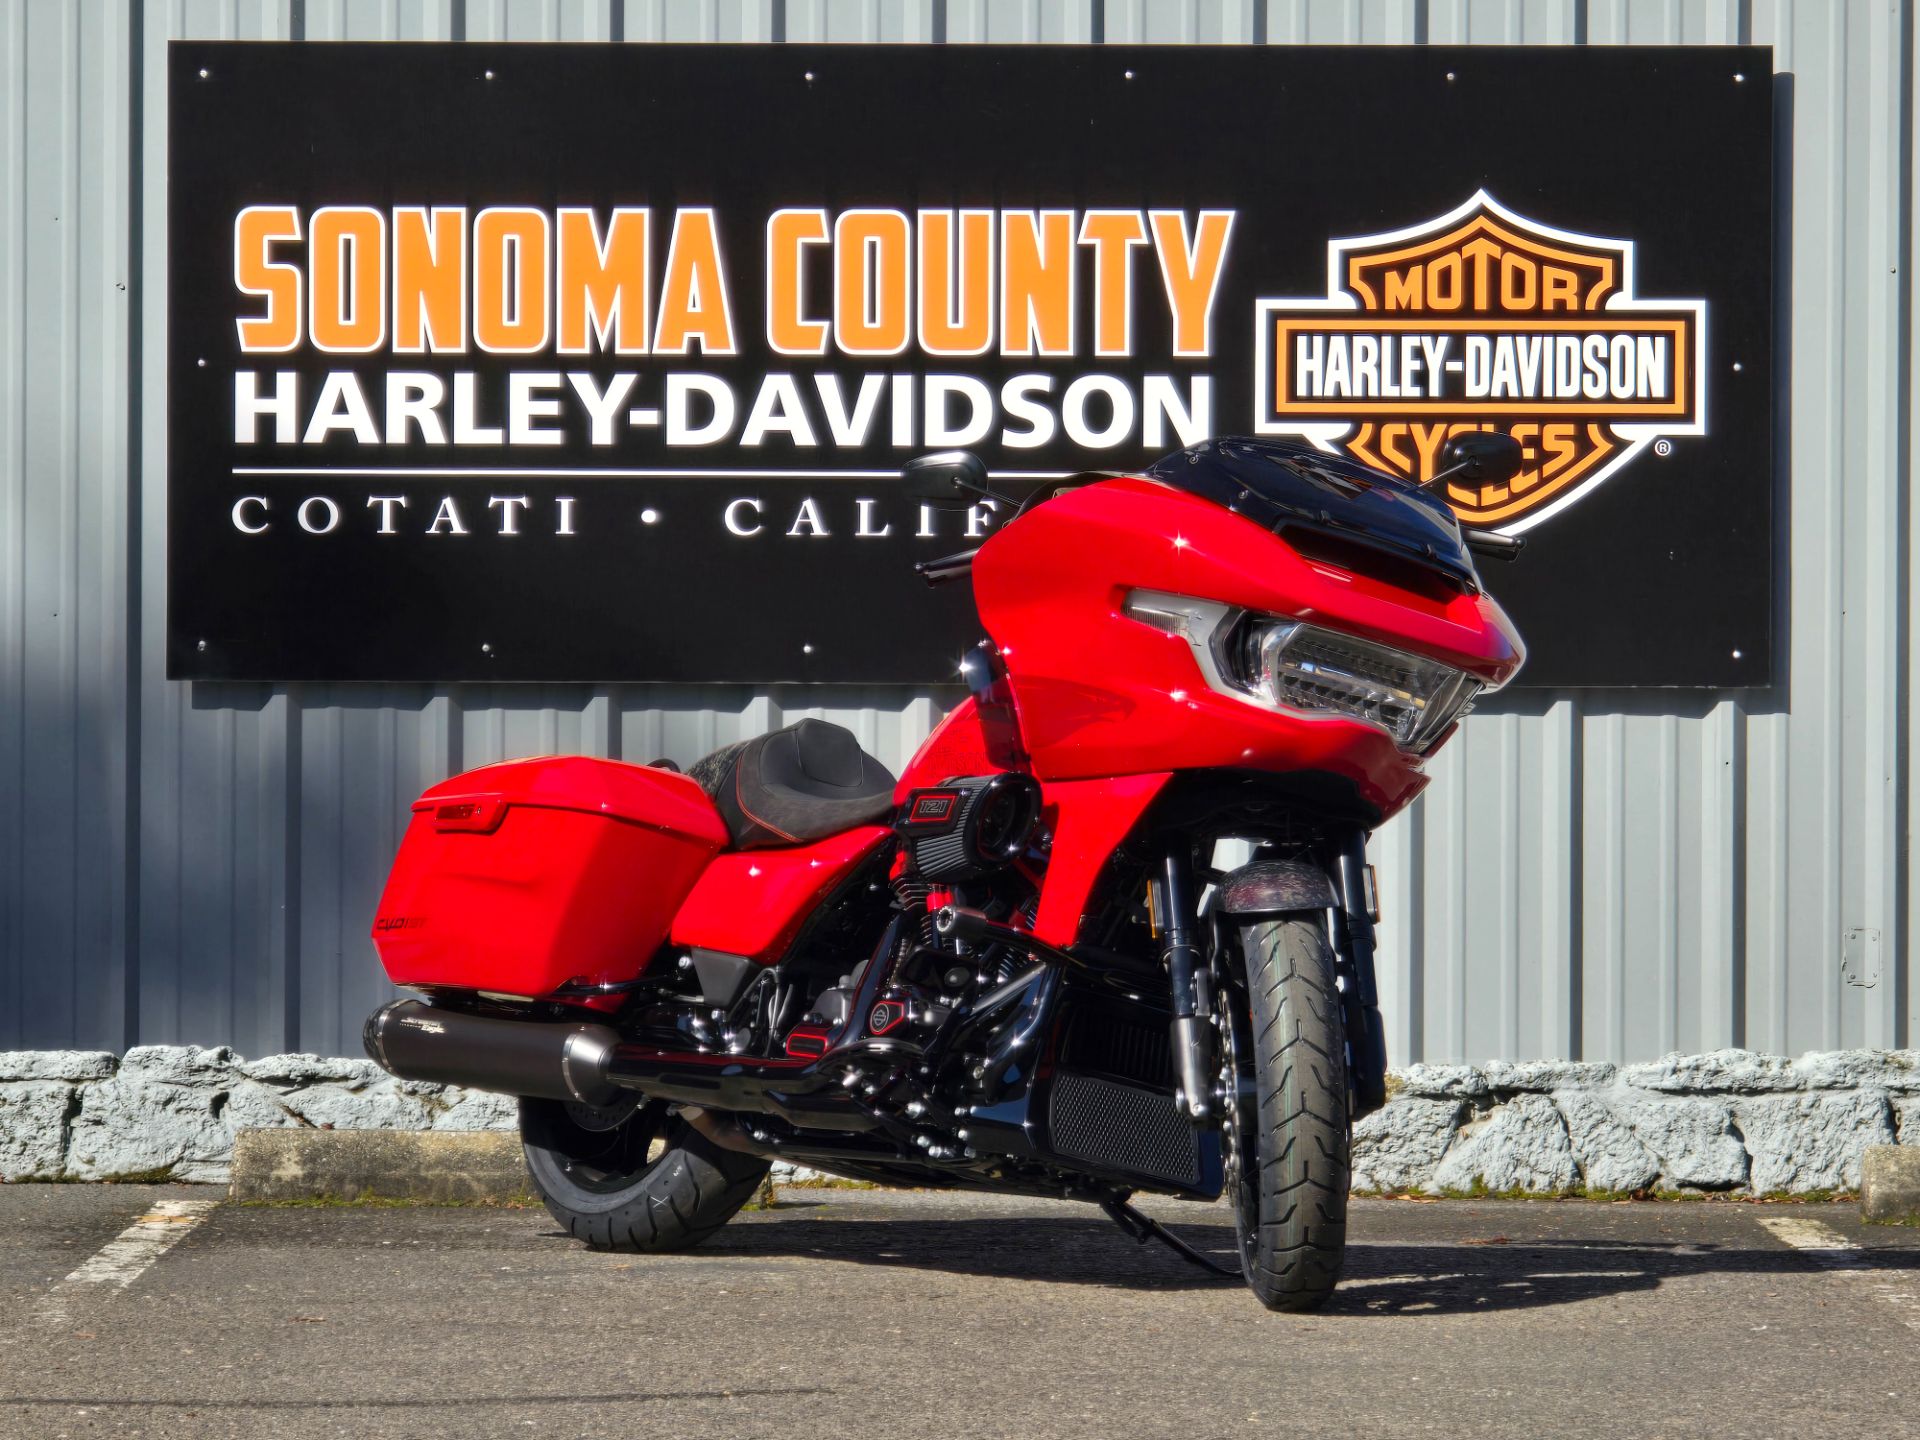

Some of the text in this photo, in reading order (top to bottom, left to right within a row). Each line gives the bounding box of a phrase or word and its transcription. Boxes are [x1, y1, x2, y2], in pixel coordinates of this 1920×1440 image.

[234, 206, 1236, 358] SONOMA COUNTY
[1385, 237, 1578, 310] MOTOR
[1297, 334, 1668, 398] HARLEY-DAVIDSON
[235, 371, 1210, 448] HARLEY-DAVIDSON
[231, 496, 576, 535] COTATI
[919, 800, 948, 813] 121
